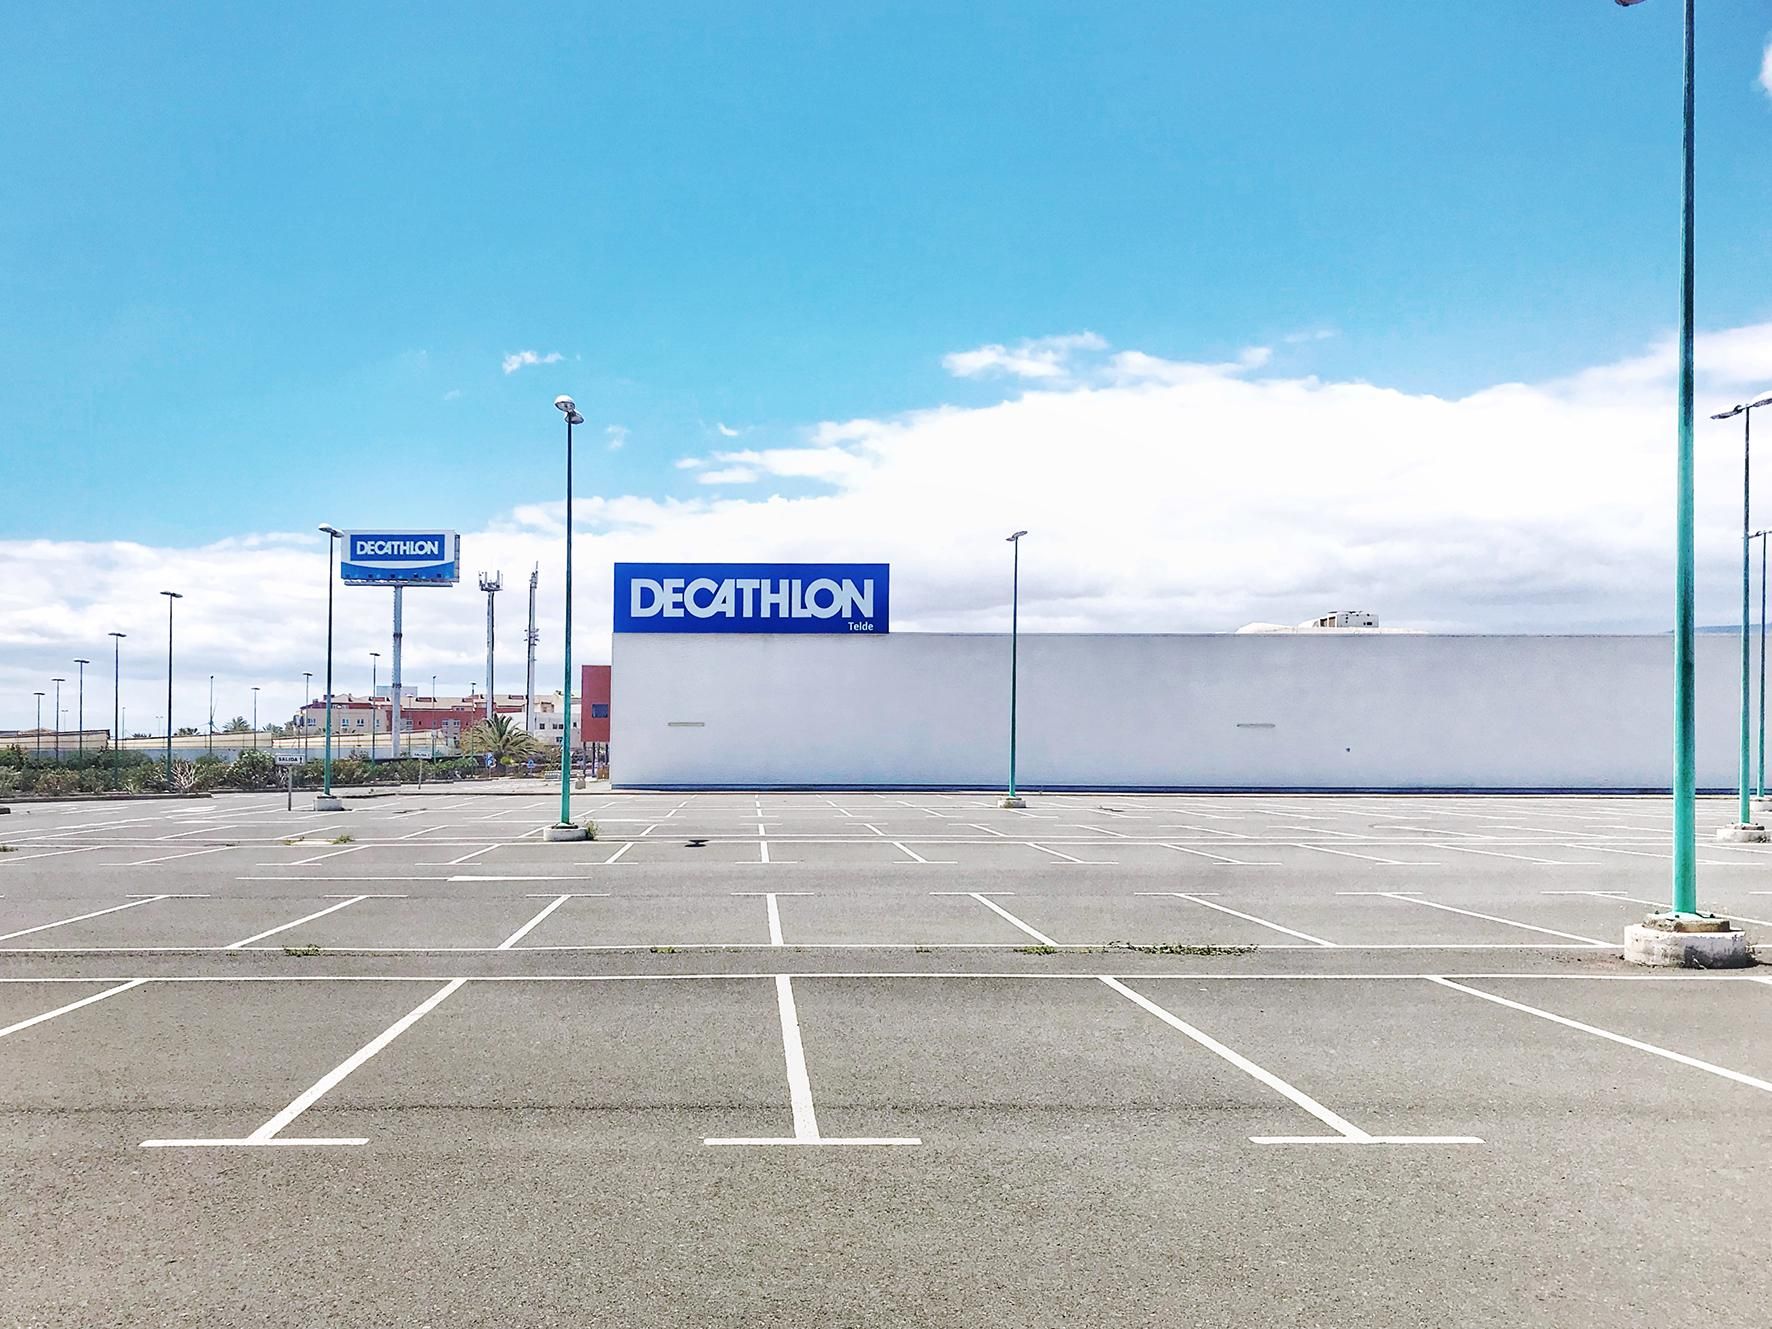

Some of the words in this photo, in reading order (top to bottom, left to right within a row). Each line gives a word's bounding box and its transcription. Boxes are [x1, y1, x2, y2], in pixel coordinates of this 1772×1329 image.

[356, 541, 439, 555] DECATHLON
[630, 577, 874, 619] DECATHLON
[847, 621, 874, 632] Telde
